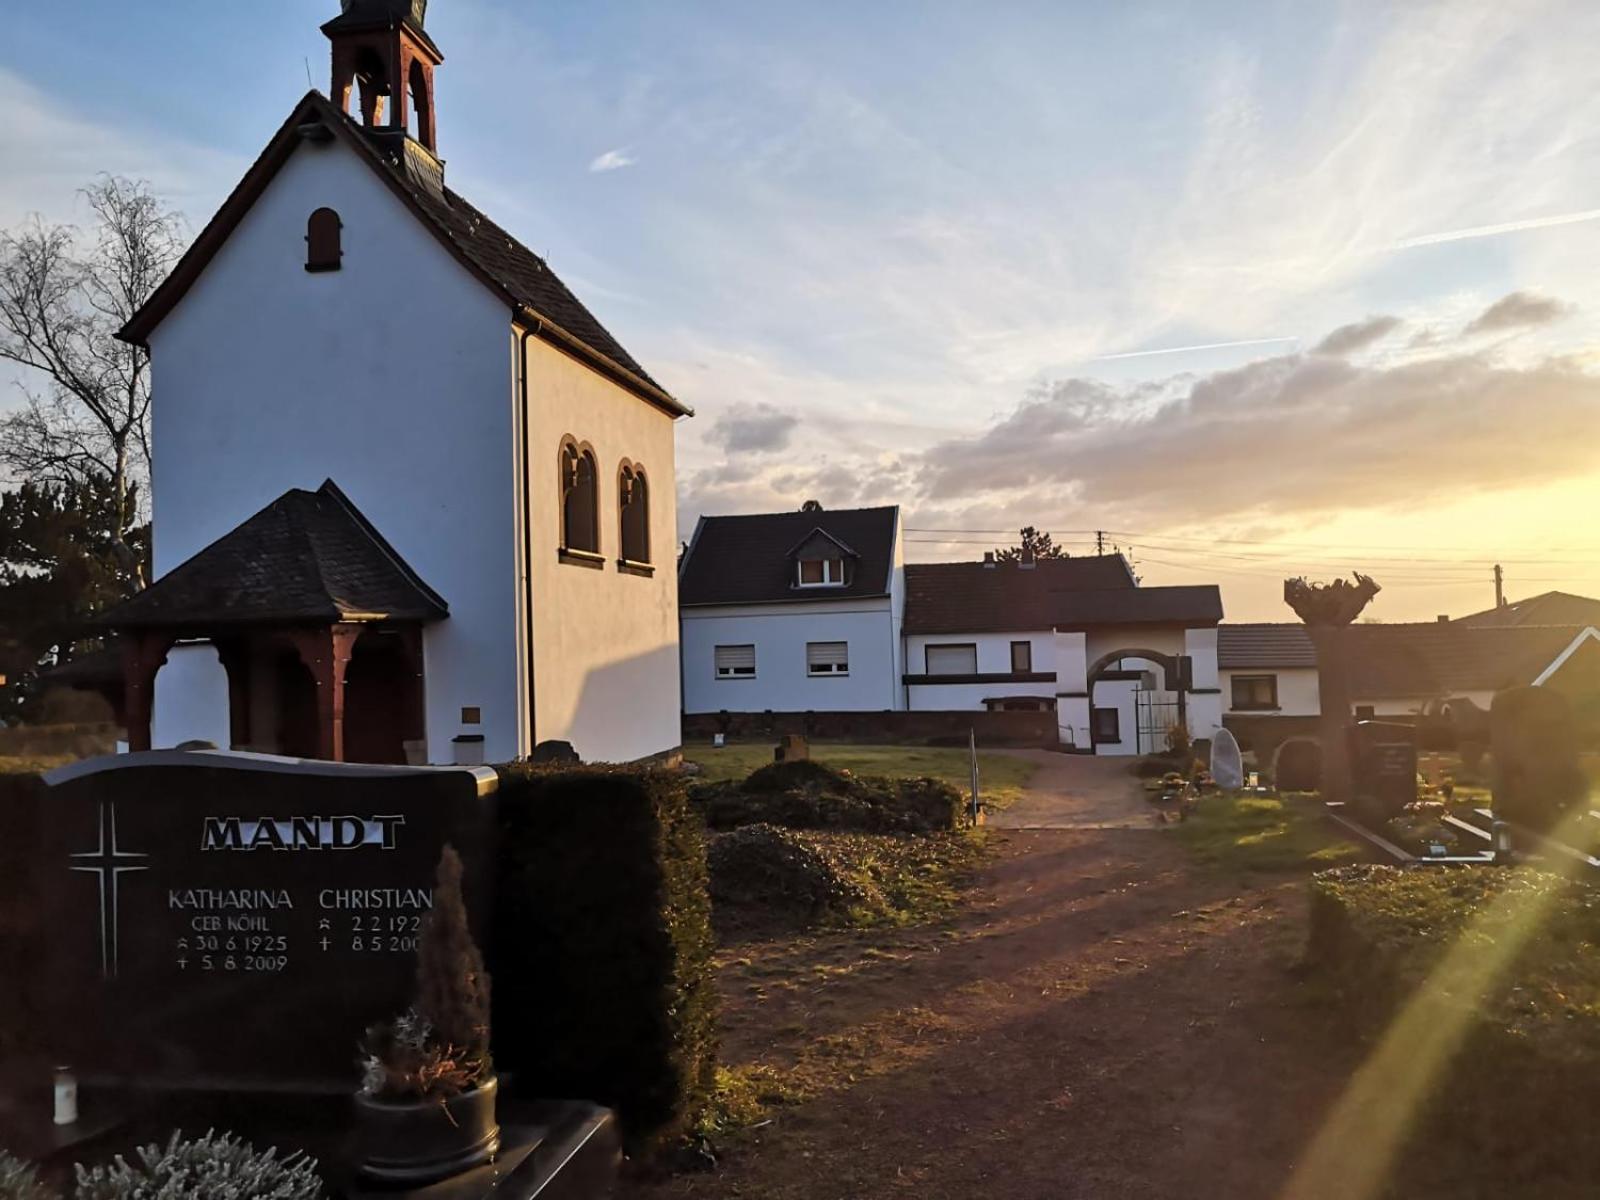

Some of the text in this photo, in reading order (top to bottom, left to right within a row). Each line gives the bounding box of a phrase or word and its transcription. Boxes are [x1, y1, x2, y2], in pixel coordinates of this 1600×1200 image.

[200, 815, 406, 851] MANDT
[168, 889, 294, 909] KATHARINA
[319, 888, 433, 909] CHRISTIAN
[227, 913, 271, 932] KÖHL
[389, 916, 425, 932] 192
[245, 936, 288, 952] 1925
[243, 955, 288, 971] 2009
